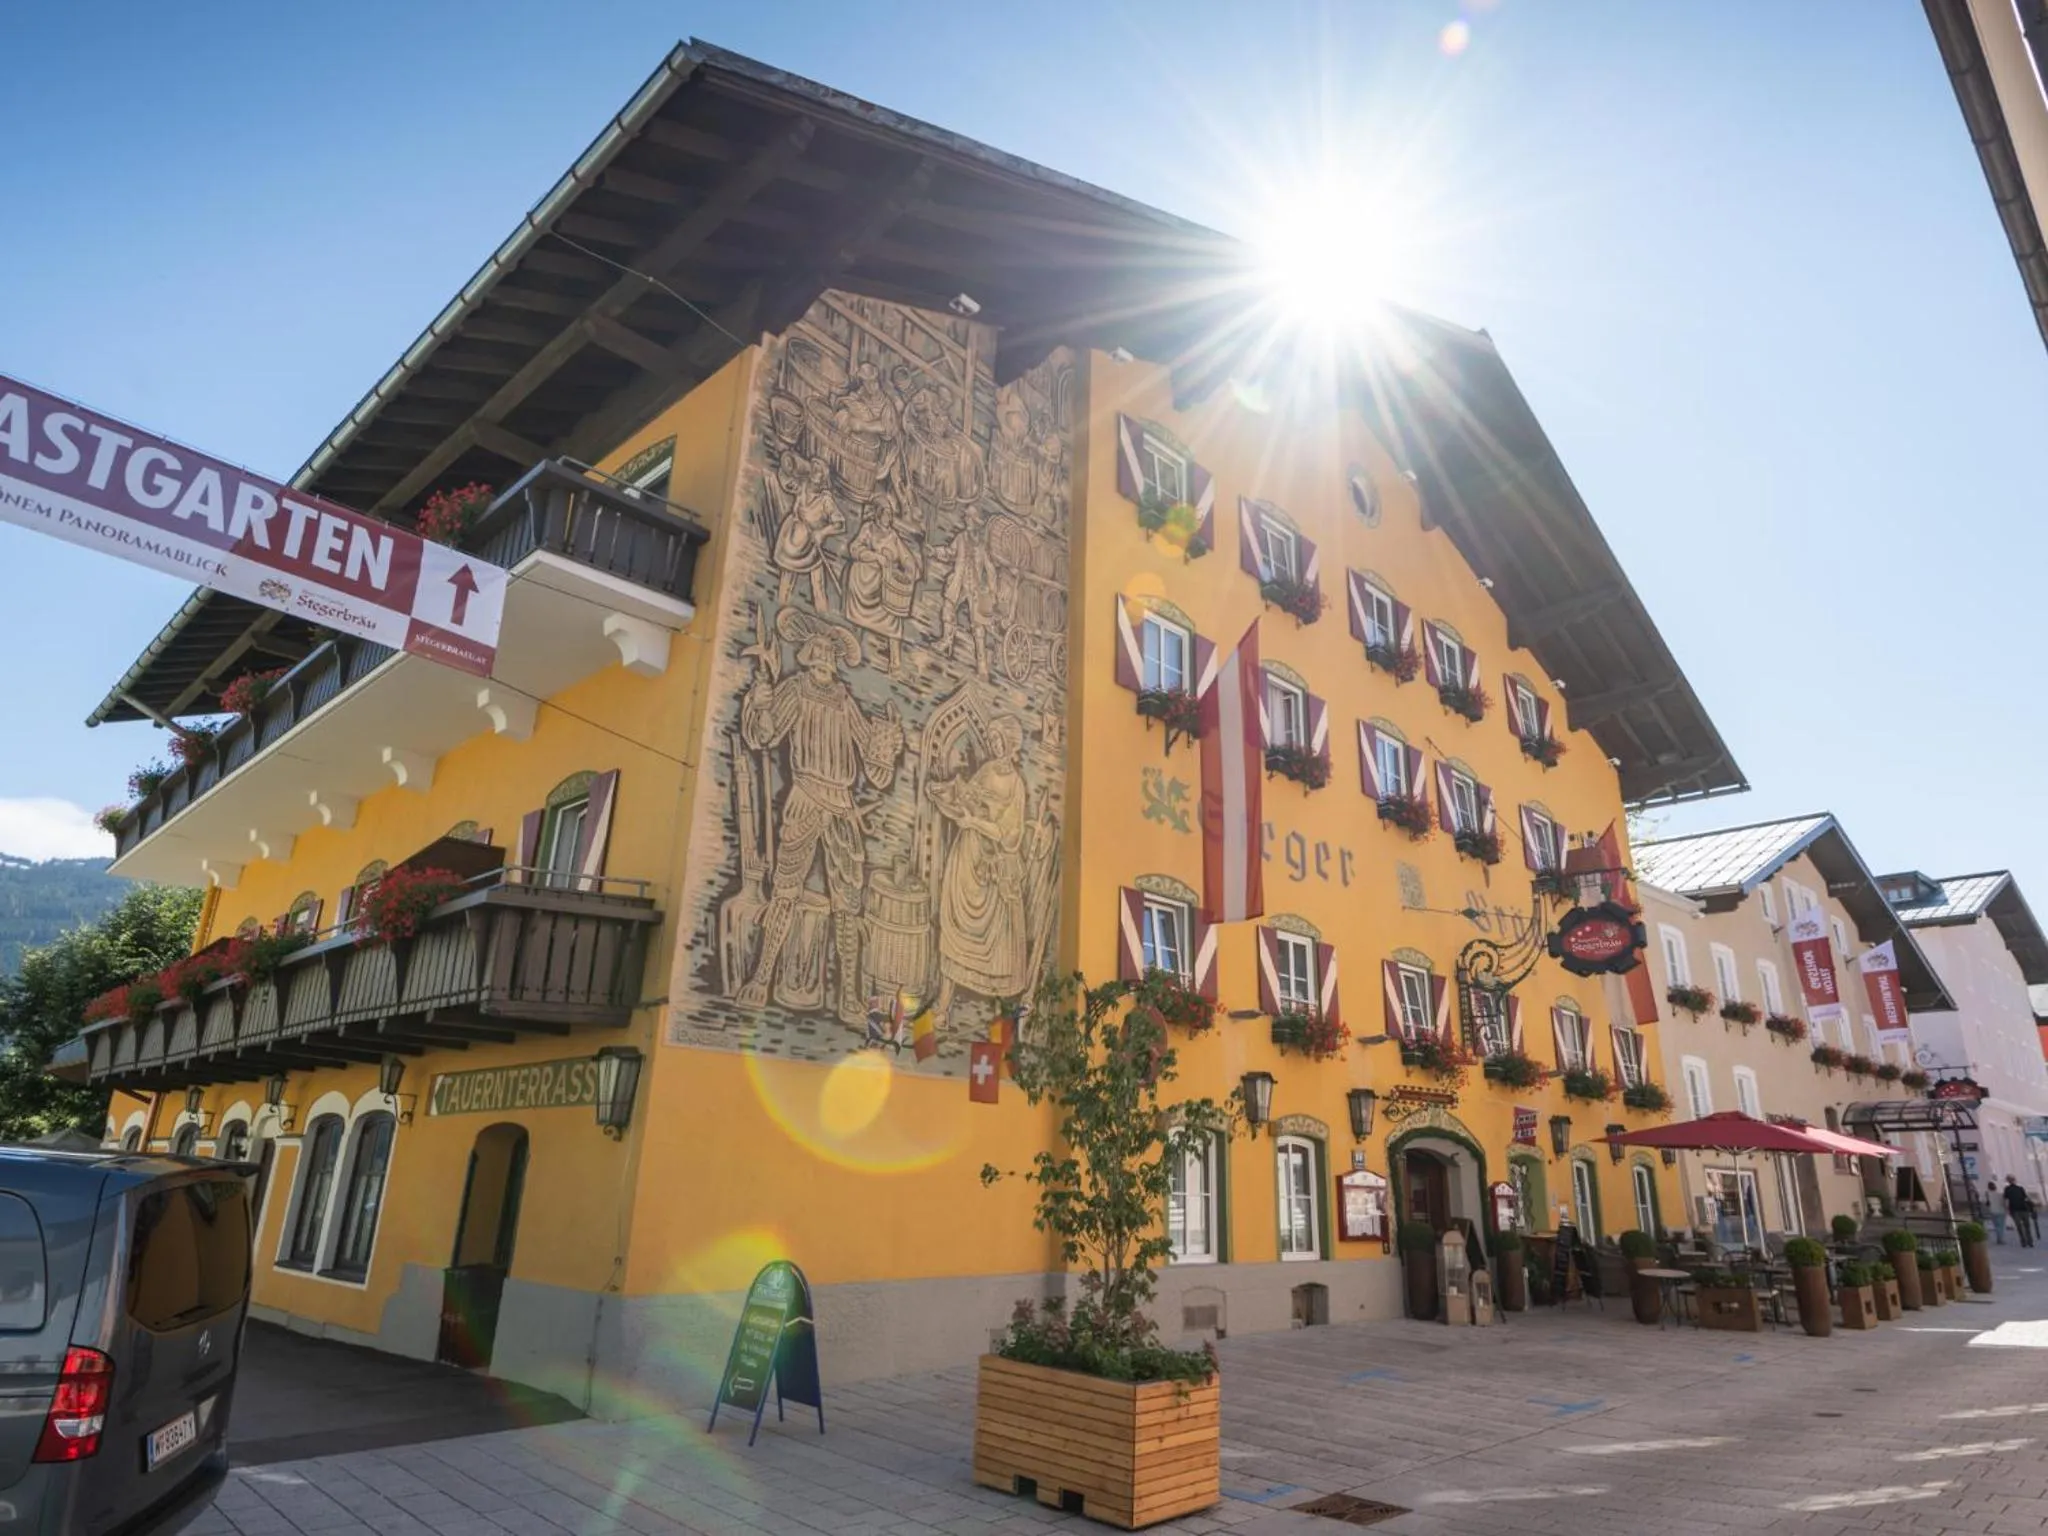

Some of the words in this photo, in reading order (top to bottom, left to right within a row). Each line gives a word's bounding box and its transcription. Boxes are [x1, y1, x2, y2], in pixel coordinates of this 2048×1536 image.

[0, 392, 393, 592] ASTGARTEN
[0, 487, 51, 518] NEM
[58, 508, 228, 577] PANORAMABLICK
[296, 594, 377, 630] Stegerbräu
[440, 1062, 599, 1112] TAUERNTERRASS
